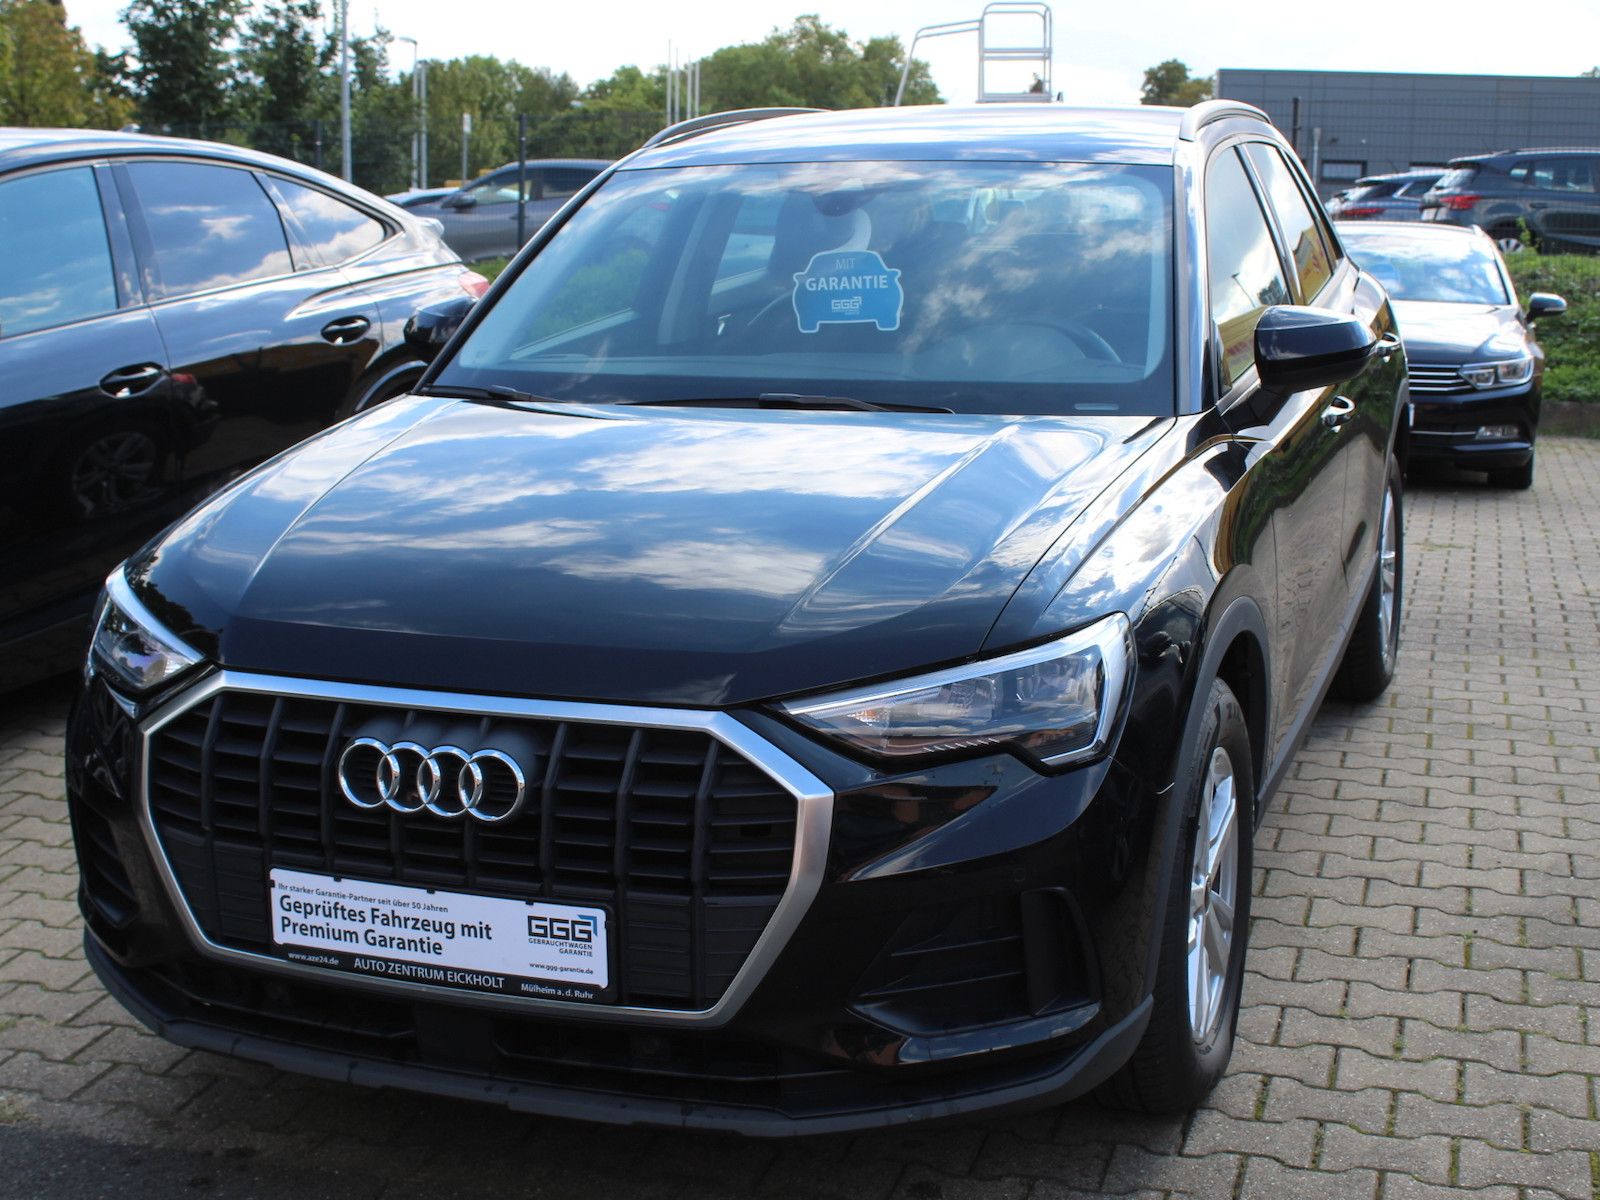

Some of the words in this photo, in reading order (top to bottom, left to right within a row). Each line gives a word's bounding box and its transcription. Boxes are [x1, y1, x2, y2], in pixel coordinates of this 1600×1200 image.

[836, 258, 856, 270] MIT
[805, 275, 888, 291] GARANTIE
[290, 885, 314, 895] starker
[315, 888, 376, 904] Garantie-Partner
[378, 898, 391, 906] seit
[393, 899, 410, 908] über
[412, 901, 421, 909] 50
[422, 903, 449, 913] Jahren
[280, 895, 366, 923] Geprüftes
[371, 908, 455, 940] Fahrzeug
[461, 921, 492, 940] mit
[281, 916, 359, 944] Premium
[364, 929, 443, 955] Garantie
[528, 915, 592, 942] GGG
[528, 938, 593, 950] GEBRAUCHTWAGEN
[559, 948, 593, 957] GARANTIE
[354, 958, 386, 973] AUTO
[388, 962, 444, 981] ZENTRUM
[447, 972, 505, 989] EICKHOLT
[521, 983, 556, 995] Mülheim
[574, 990, 593, 999] Ruhr
[529, 962, 594, 975] www.ggg-garantie.de
